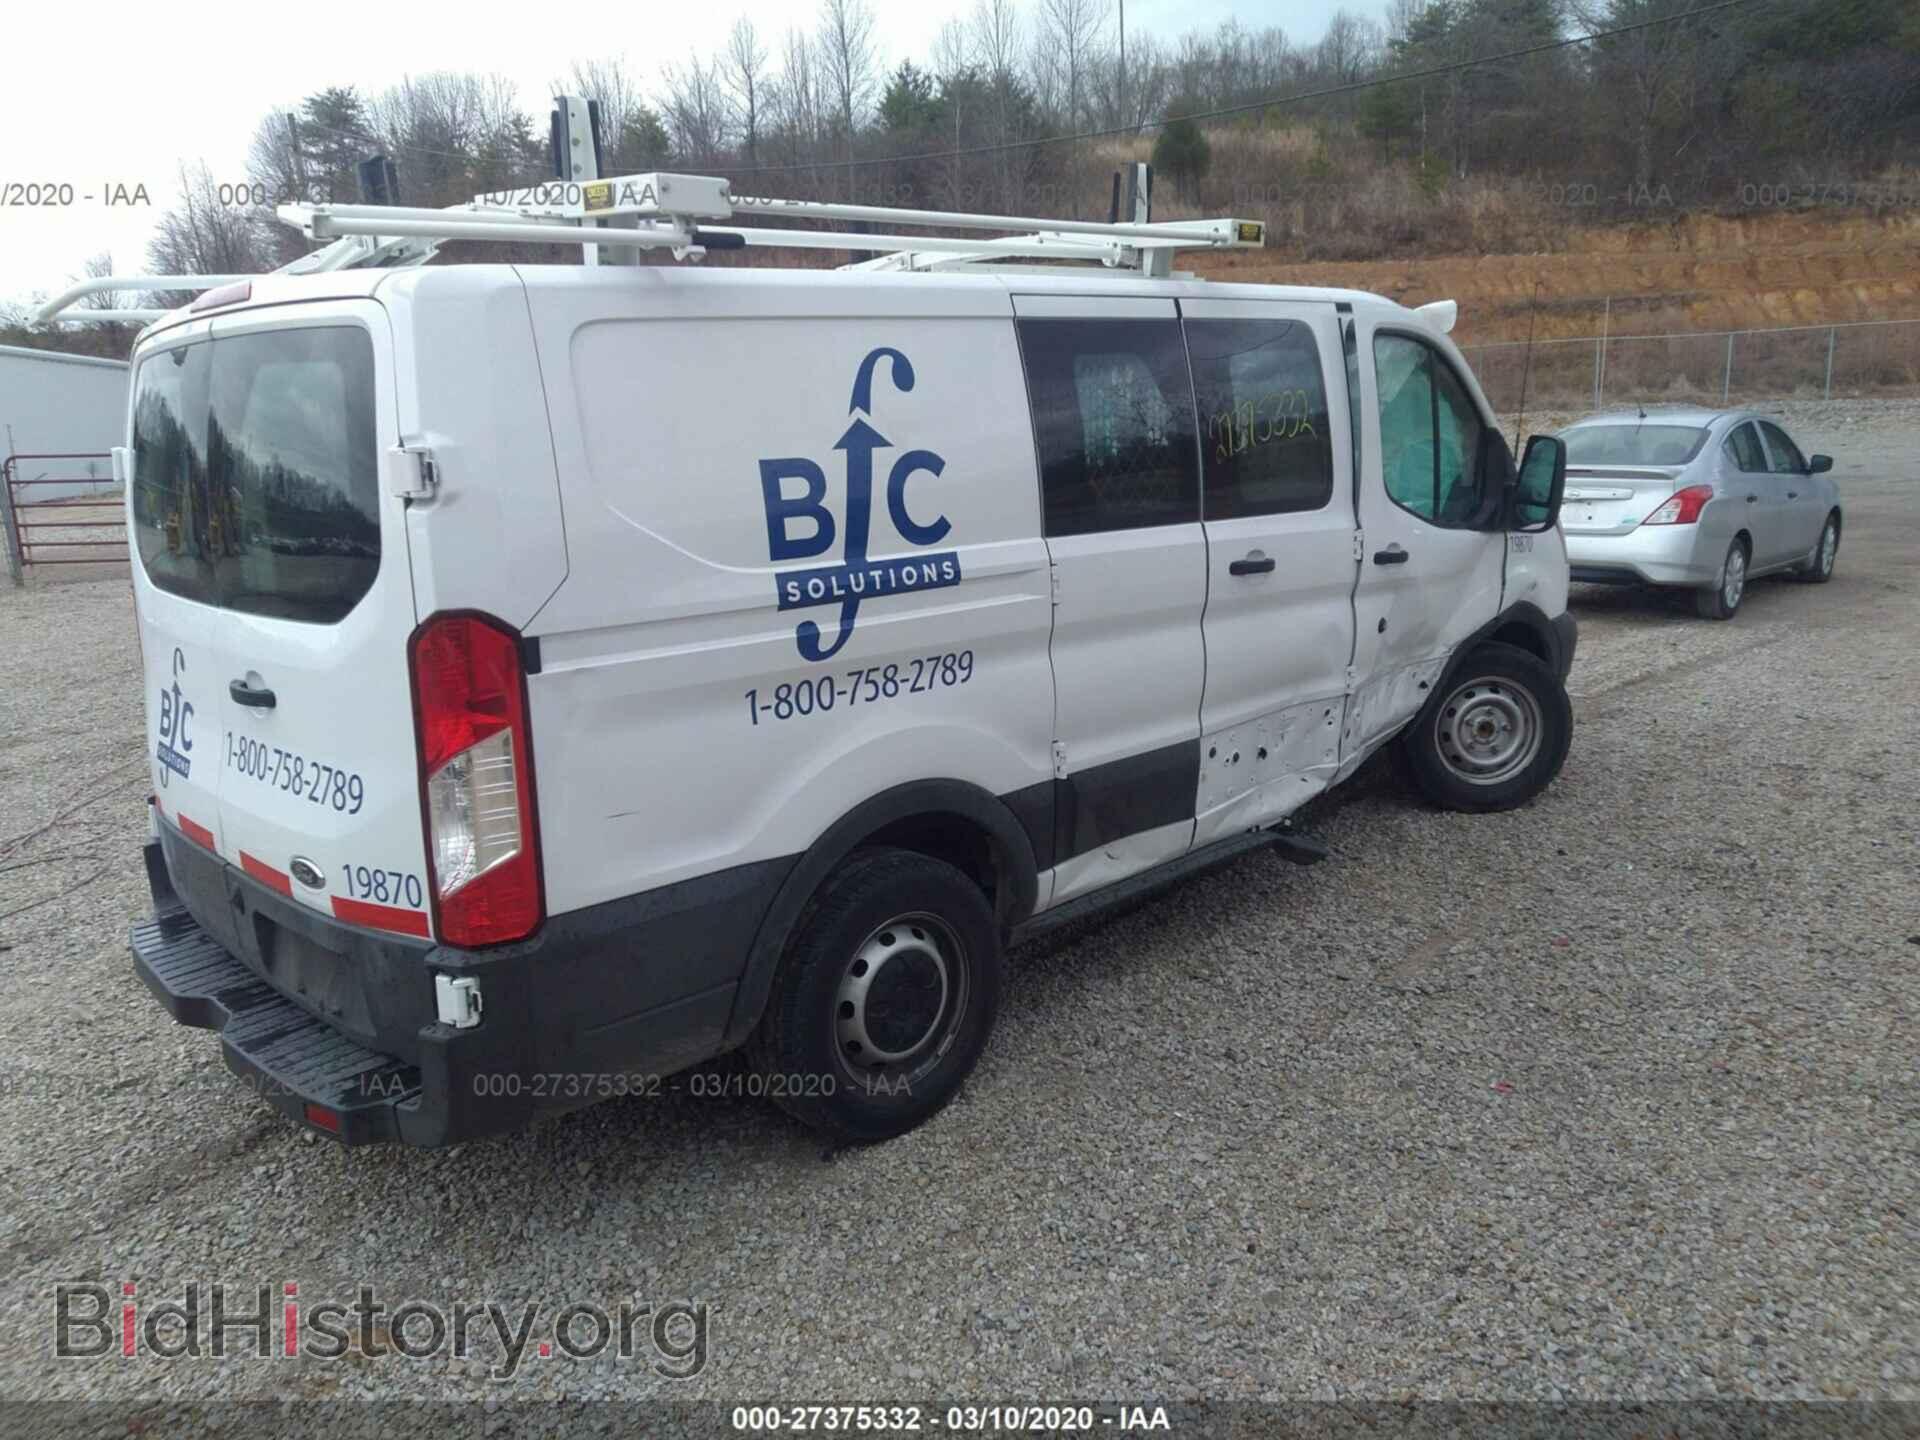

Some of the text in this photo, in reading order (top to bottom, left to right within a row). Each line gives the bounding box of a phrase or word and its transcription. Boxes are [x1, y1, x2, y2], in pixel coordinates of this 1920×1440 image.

[785, 560, 956, 603] SOLUTIONS
[744, 649, 975, 726] 1-800-758-2789
[226, 731, 364, 815] 1-800-758-2789
[342, 863, 422, 908] 19870
